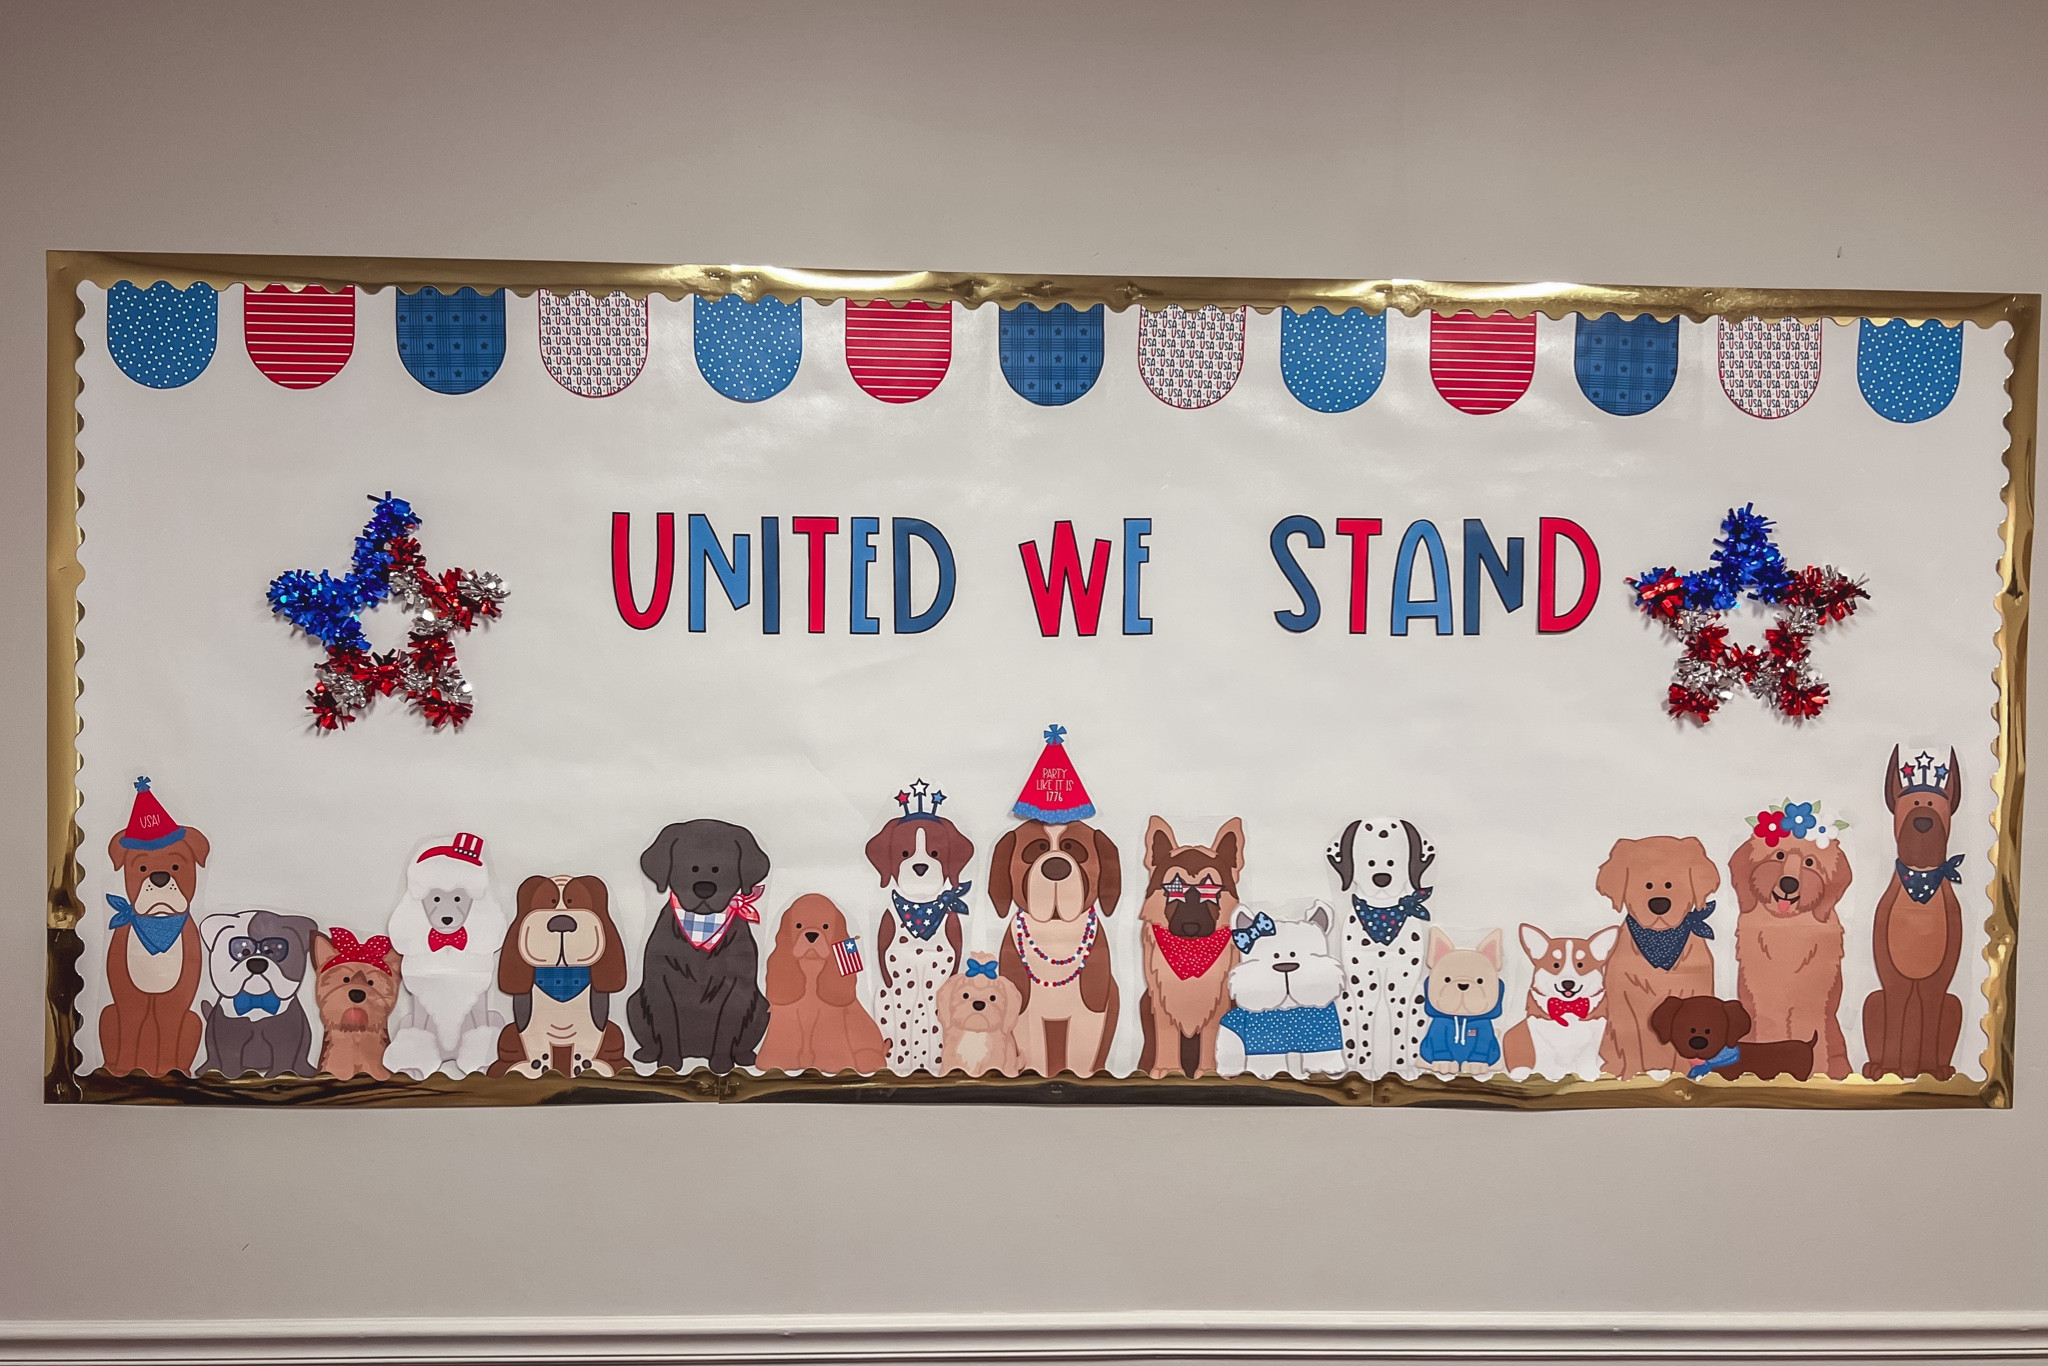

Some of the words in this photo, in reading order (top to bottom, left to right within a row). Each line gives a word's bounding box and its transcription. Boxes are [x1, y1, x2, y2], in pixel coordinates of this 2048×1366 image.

[540, 296, 550, 305] SA
[555, 297, 570, 306] USA
[575, 297, 590, 306] USA
[595, 297, 610, 306] USA
[615, 298, 630, 307] USA
[634, 298, 645, 307] US
[545, 306, 560, 315] USA
[565, 307, 580, 316] USA
[585, 307, 600, 316] USA
[605, 307, 620, 316] USA
[625, 308, 640, 317] USA
[1172, 310, 1186, 319] USA
[1191, 311, 1206, 320] USA
[1210, 312, 1225, 321] USA
[541, 316, 550, 325] SA
[555, 316, 570, 325] USA
[575, 317, 590, 326] USA
[595, 317, 610, 326] USA
[615, 317, 630, 326] USA
[634, 317, 645, 326] US
[1143, 318, 1157, 327] USA
[1162, 319, 1176, 328] USA
[1181, 320, 1195, 329] USA
[1200, 321, 1215, 330] USA
[1219, 322, 1234, 331] USA
[545, 326, 560, 335] USA
[565, 326, 581, 335] USA
[585, 327, 601, 336] USA
[605, 327, 620, 336] USA
[625, 327, 640, 336] USA
[1748, 322, 1762, 331] USA
[1785, 322, 1800, 331] USA
[1152, 328, 1166, 337] USA
[1171, 329, 1185, 338] USA
[1190, 330, 1204, 339] USA
[1209, 331, 1224, 340] USA
[1229, 332, 1243, 341] USA
[1719, 331, 1734, 340] USA
[1738, 331, 1753, 340] USA
[1757, 332, 1771, 340] USA
[1776, 332, 1790, 341] USA
[1795, 332, 1809, 341] USA
[541, 336, 550, 345] SA
[555, 336, 571, 345] USA
[576, 336, 591, 345] USA
[595, 337, 611, 346] USA
[615, 337, 630, 346] USA
[635, 337, 646, 346] US
[1142, 337, 1156, 346] USA
[1161, 338, 1175, 347] USA
[1180, 339, 1194, 348] USA
[1199, 340, 1214, 349] USA
[1218, 341, 1233, 350] USA
[1729, 341, 1743, 350] USA
[1748, 341, 1762, 350] USA
[1766, 341, 1781, 350] USA
[1785, 341, 1799, 350] USA
[1804, 342, 1818, 350] USA
[545, 346, 561, 355] USA
[566, 346, 581, 355] USA
[586, 346, 601, 355] USA
[605, 347, 621, 356] USA
[625, 347, 640, 356] USA
[1151, 347, 1165, 357] USA
[1170, 348, 1184, 358] USA
[1189, 349, 1203, 358] USA
[1208, 350, 1223, 359] USA
[1227, 351, 1242, 360] USA
[1720, 350, 1734, 359] USA
[1738, 350, 1753, 359] USA
[1757, 351, 1771, 359] USA
[1776, 351, 1790, 360] USA
[1794, 351, 1809, 360] USA
[556, 356, 571, 365] USA
[576, 356, 591, 365] USA
[596, 356, 611, 365] USA
[615, 357, 631, 366] USA
[1140, 357, 1155, 366] USA
[1160, 358, 1174, 367] USA
[1179, 359, 1193, 368] USA
[1198, 359, 1212, 369] USA
[1217, 360, 1232, 370] USA
[1729, 360, 1743, 369] USA
[1748, 360, 1762, 369] USA
[1766, 360, 1780, 369] USA
[1785, 360, 1799, 369] USA
[1803, 361, 1818, 370] USA
[566, 366, 581, 375] USA
[586, 366, 601, 375] USA
[606, 366, 621, 375] USA
[1150, 367, 1164, 376] USA
[1169, 368, 1183, 377] USA
[1188, 369, 1202, 378] USA
[1207, 370, 1222, 379] USA
[1720, 369, 1734, 378] USA
[1738, 369, 1753, 378] USA
[1757, 370, 1771, 379] USA
[1775, 370, 1790, 379] USA
[1794, 370, 1808, 379] USA
[576, 376, 591, 385] USA
[596, 376, 611, 385] USA
[1145, 376, 1154, 385] SA
[1159, 377, 1173, 386] USA
[1178, 378, 1192, 387] USA
[1197, 379, 1211, 388] USA
[1216, 380, 1231, 389] USA
[1729, 379, 1743, 388] USA
[1748, 379, 1762, 388] USA
[1766, 379, 1780, 388] USA
[1785, 380, 1799, 389] USA
[586, 386, 601, 395] USA
[1168, 387, 1182, 397] USA
[1187, 388, 1201, 397] USA
[1206, 389, 1220, 398] USA
[1738, 388, 1753, 397] USA
[1757, 389, 1771, 398] USA
[1775, 389, 1790, 398] USA
[1794, 389, 1808, 398] USA
[1177, 398, 1191, 407] USA
[1748, 398, 1762, 407] USA
[1766, 399, 1780, 407] USA
[1784, 399, 1799, 408] USA
[1757, 408, 1771, 417] USA
[611, 512, 956, 634] UNITED
[1018, 517, 1153, 636] WE
[1269, 515, 1601, 636] STAND
[1042, 768, 1068, 779] PARTY
[1036, 780, 1052, 790] LIKE
[1055, 780, 1064, 790] IT
[1065, 780, 1074, 791] IS
[1046, 791, 1063, 802] 1776
[139, 814, 160, 829] USA!
